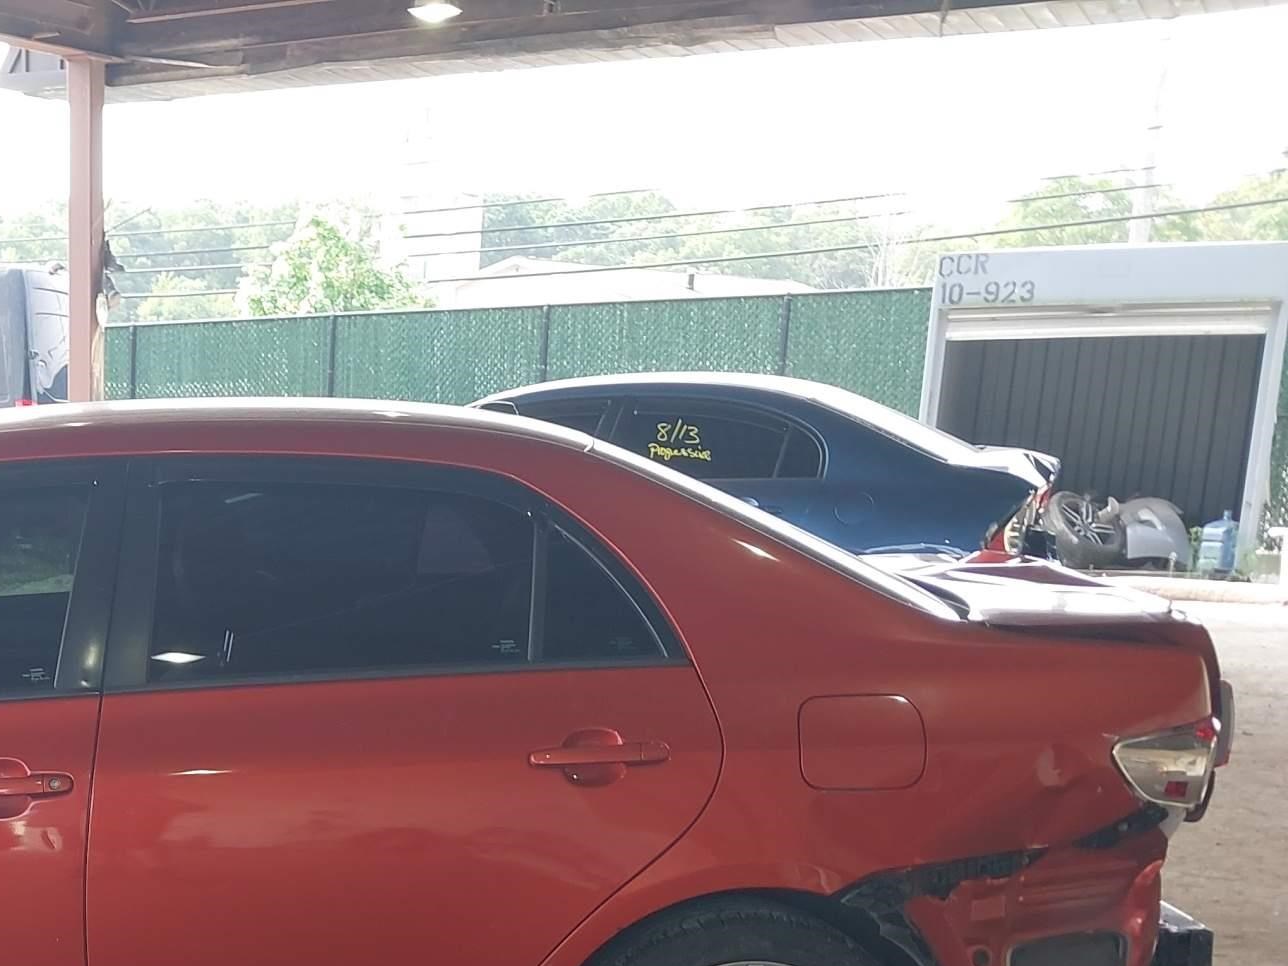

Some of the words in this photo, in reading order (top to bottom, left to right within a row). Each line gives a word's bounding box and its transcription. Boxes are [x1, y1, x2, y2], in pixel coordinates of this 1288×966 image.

[938, 253, 990, 278] CCR
[940, 280, 1036, 305] 10-923
[656, 418, 701, 444] 8/13
